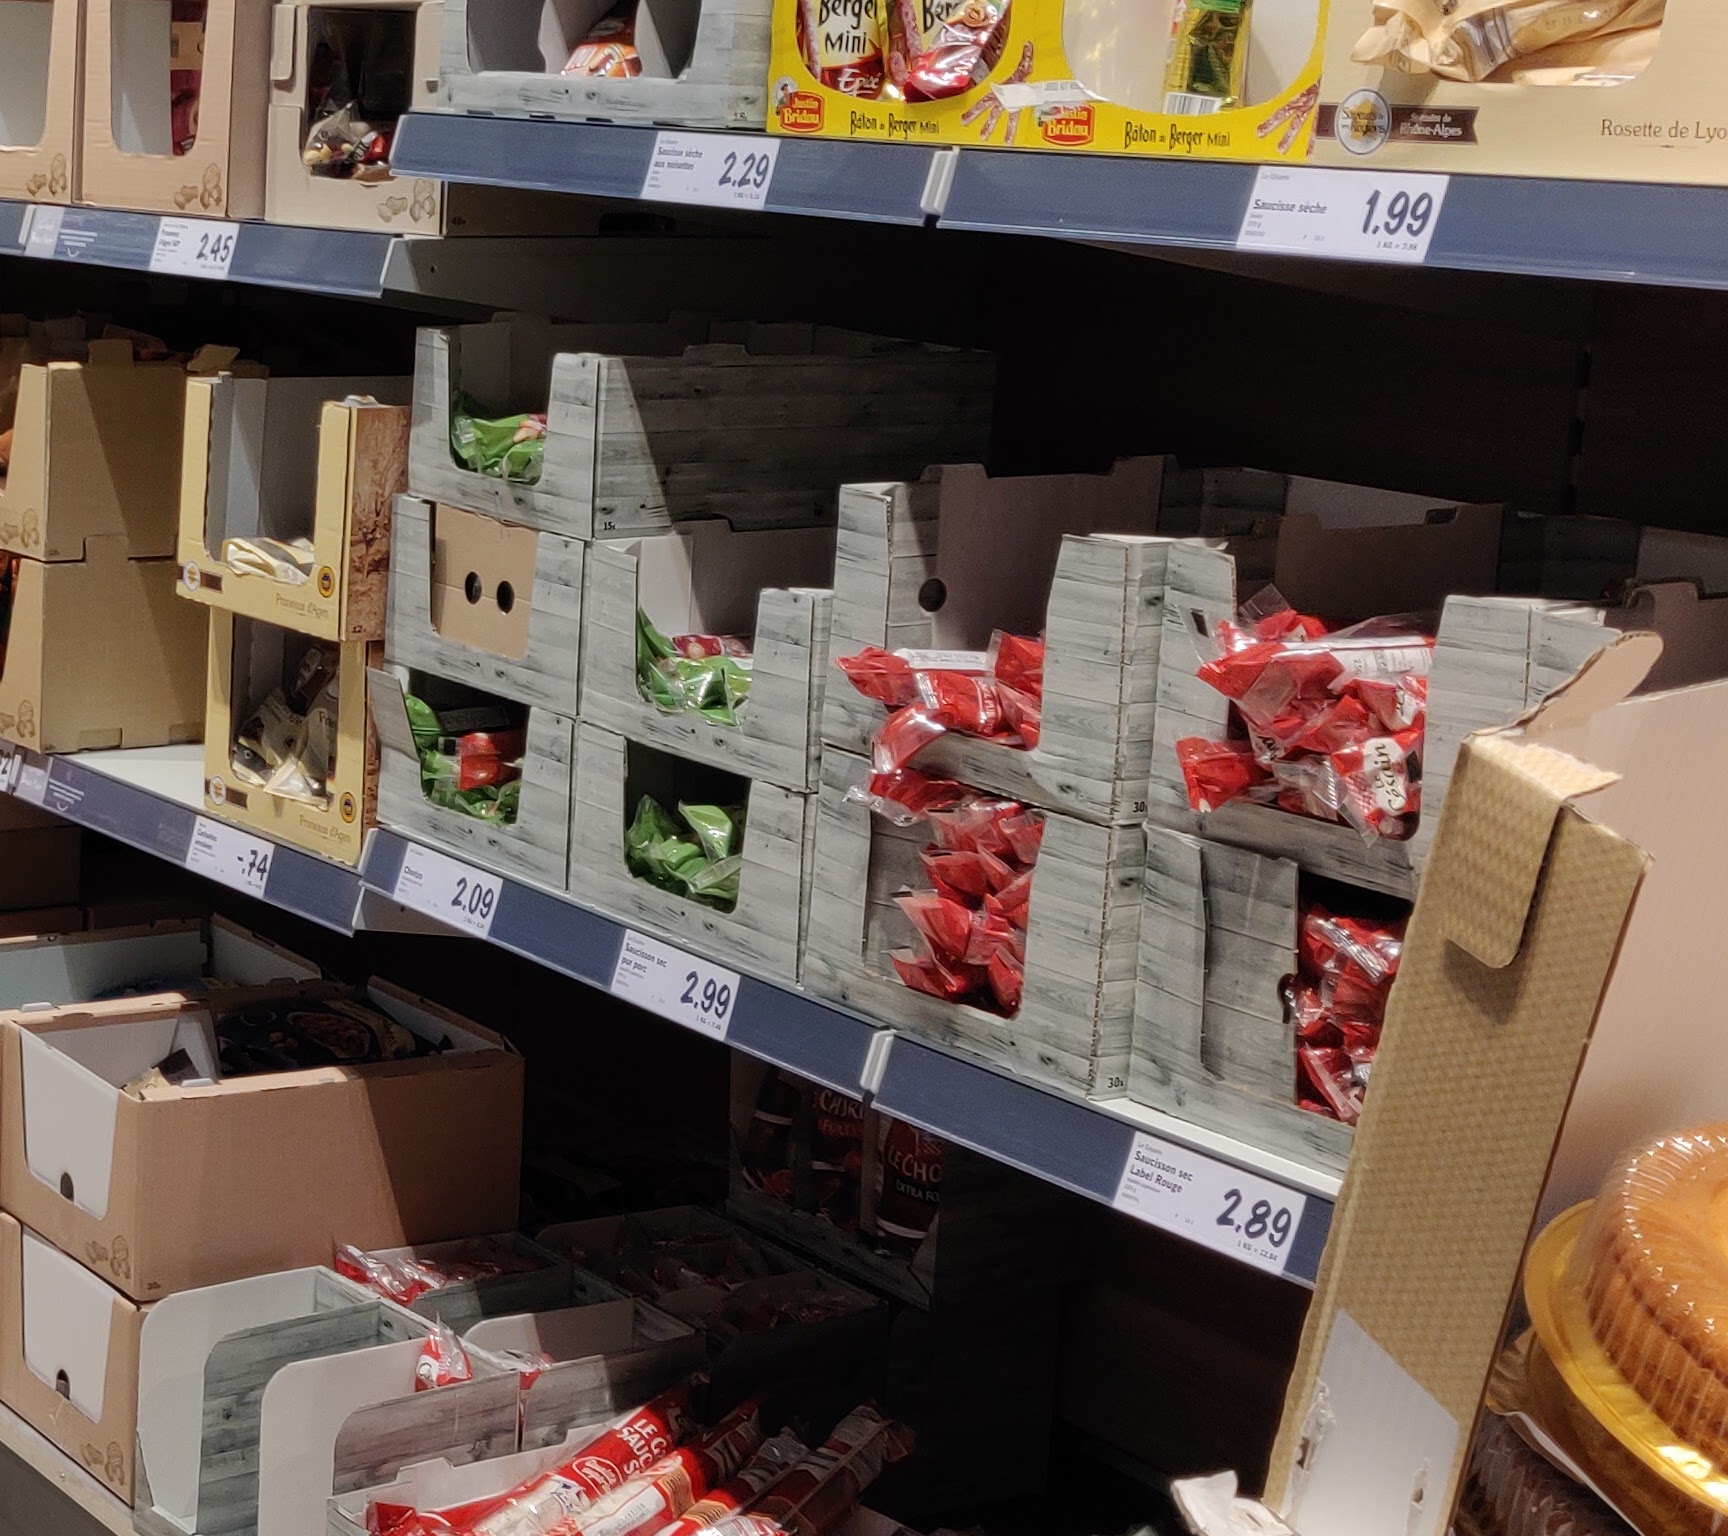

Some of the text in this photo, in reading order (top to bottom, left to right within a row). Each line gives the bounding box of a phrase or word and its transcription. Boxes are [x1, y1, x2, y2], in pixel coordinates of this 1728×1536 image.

[825, 31, 867, 55] Mini
[888, 113, 917, 140] Berger
[1047, 121, 1087, 136] Bridou
[1124, 120, 1230, 154] Bâton Berger Mini
[1400, 123, 1463, 138] Rhône-Alpes
[1601, 119, 1728, 143] Rosette de Lyo
[718, 151, 770, 189] 2.29
[1362, 188, 1433, 237] 1.99
[196, 232, 233, 263] 2.45
[451, 877, 494, 919] 2.09
[621, 956, 647, 973] pur porc
[625, 942, 667, 968] Saucisson sec
[680, 970, 731, 1019] 2.99
[902, 1153, 942, 1183] CHO
[1130, 1164, 1154, 1183] Label
[1155, 1174, 1183, 1194] Rouge
[1134, 1150, 1194, 1182] Saucisson sec
[1216, 1188, 1292, 1248] 2.89
[633, 1418, 657, 1440] LE
[616, 1426, 653, 1470] SAUC
